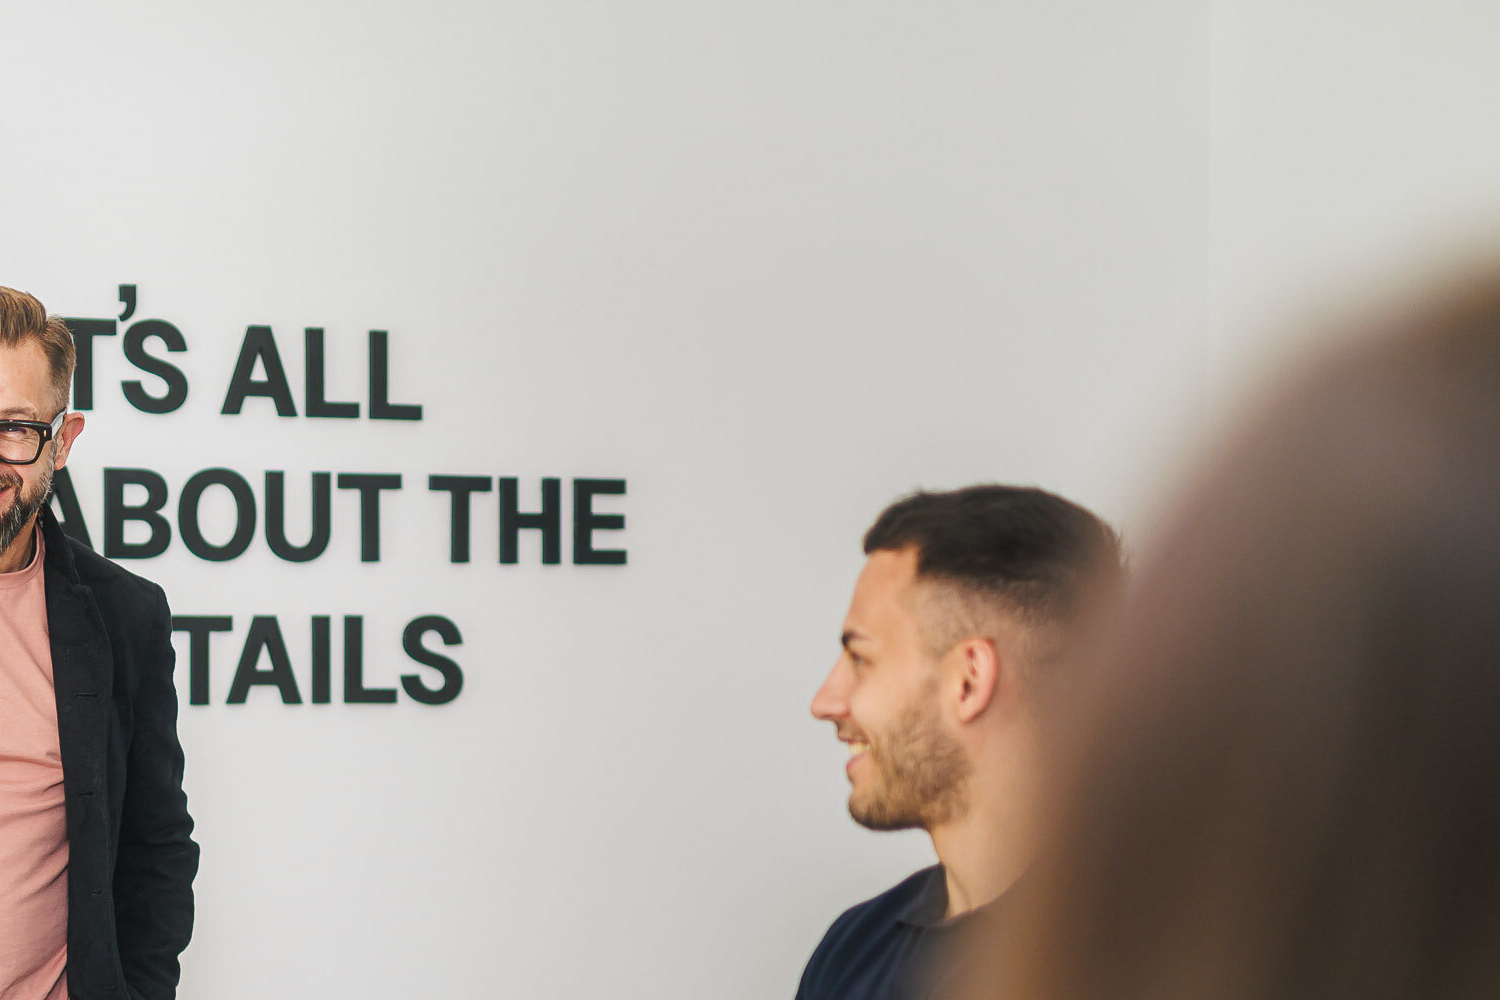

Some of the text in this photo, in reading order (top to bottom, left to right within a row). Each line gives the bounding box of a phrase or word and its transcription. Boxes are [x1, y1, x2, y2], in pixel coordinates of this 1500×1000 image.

[61, 284, 423, 421] T'S ALL
[429, 475, 628, 565] THE
[172, 614, 464, 706] TAILS
